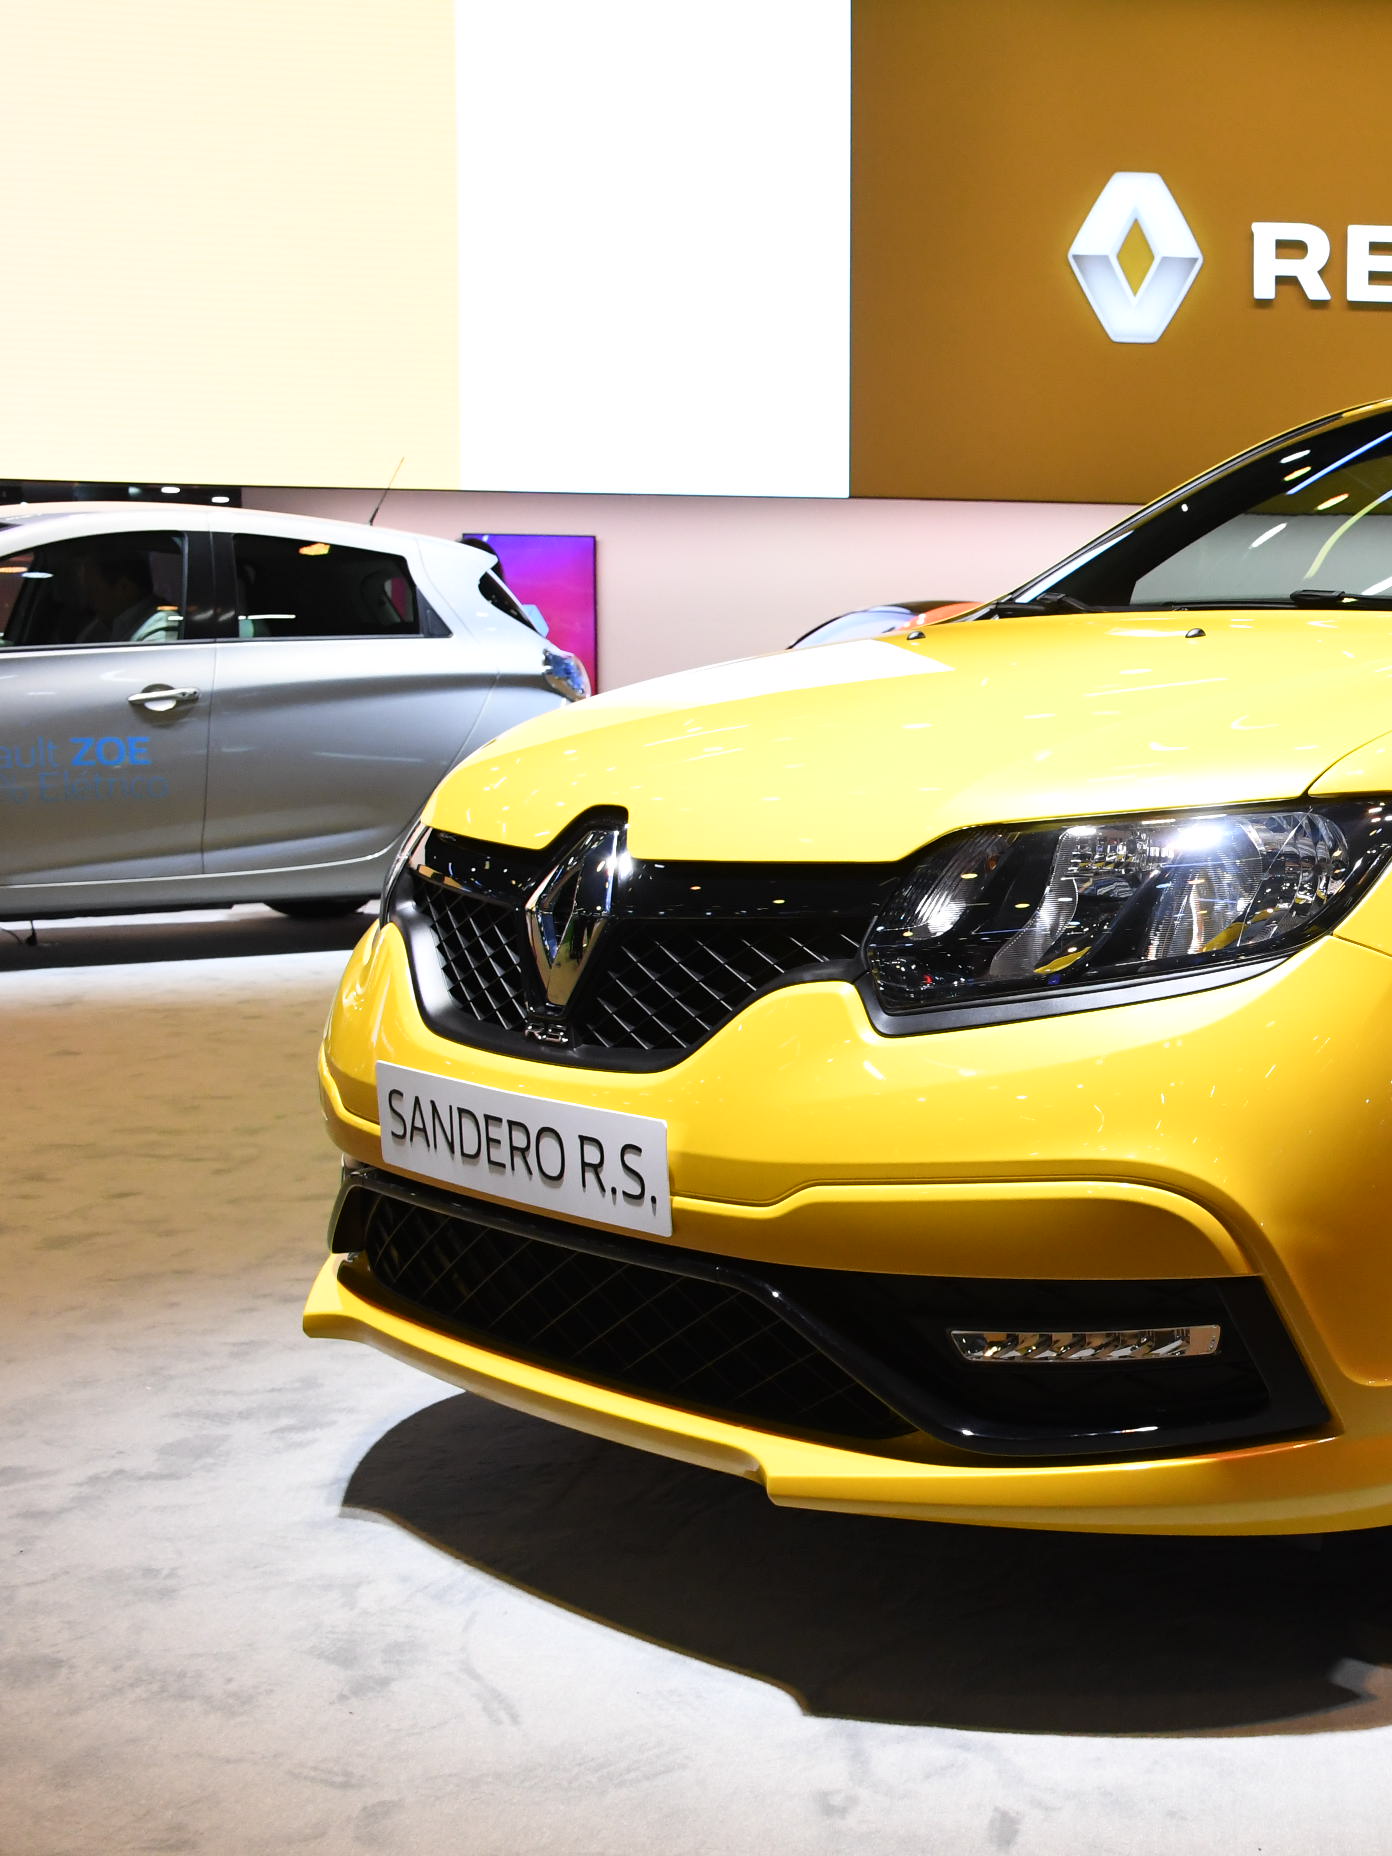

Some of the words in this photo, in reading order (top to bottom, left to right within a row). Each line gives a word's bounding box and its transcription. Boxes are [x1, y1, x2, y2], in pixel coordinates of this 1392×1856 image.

[69, 736, 153, 767] ZOE
[388, 1089, 567, 1182] SANDERO
[578, 1134, 657, 1204] R.S.
